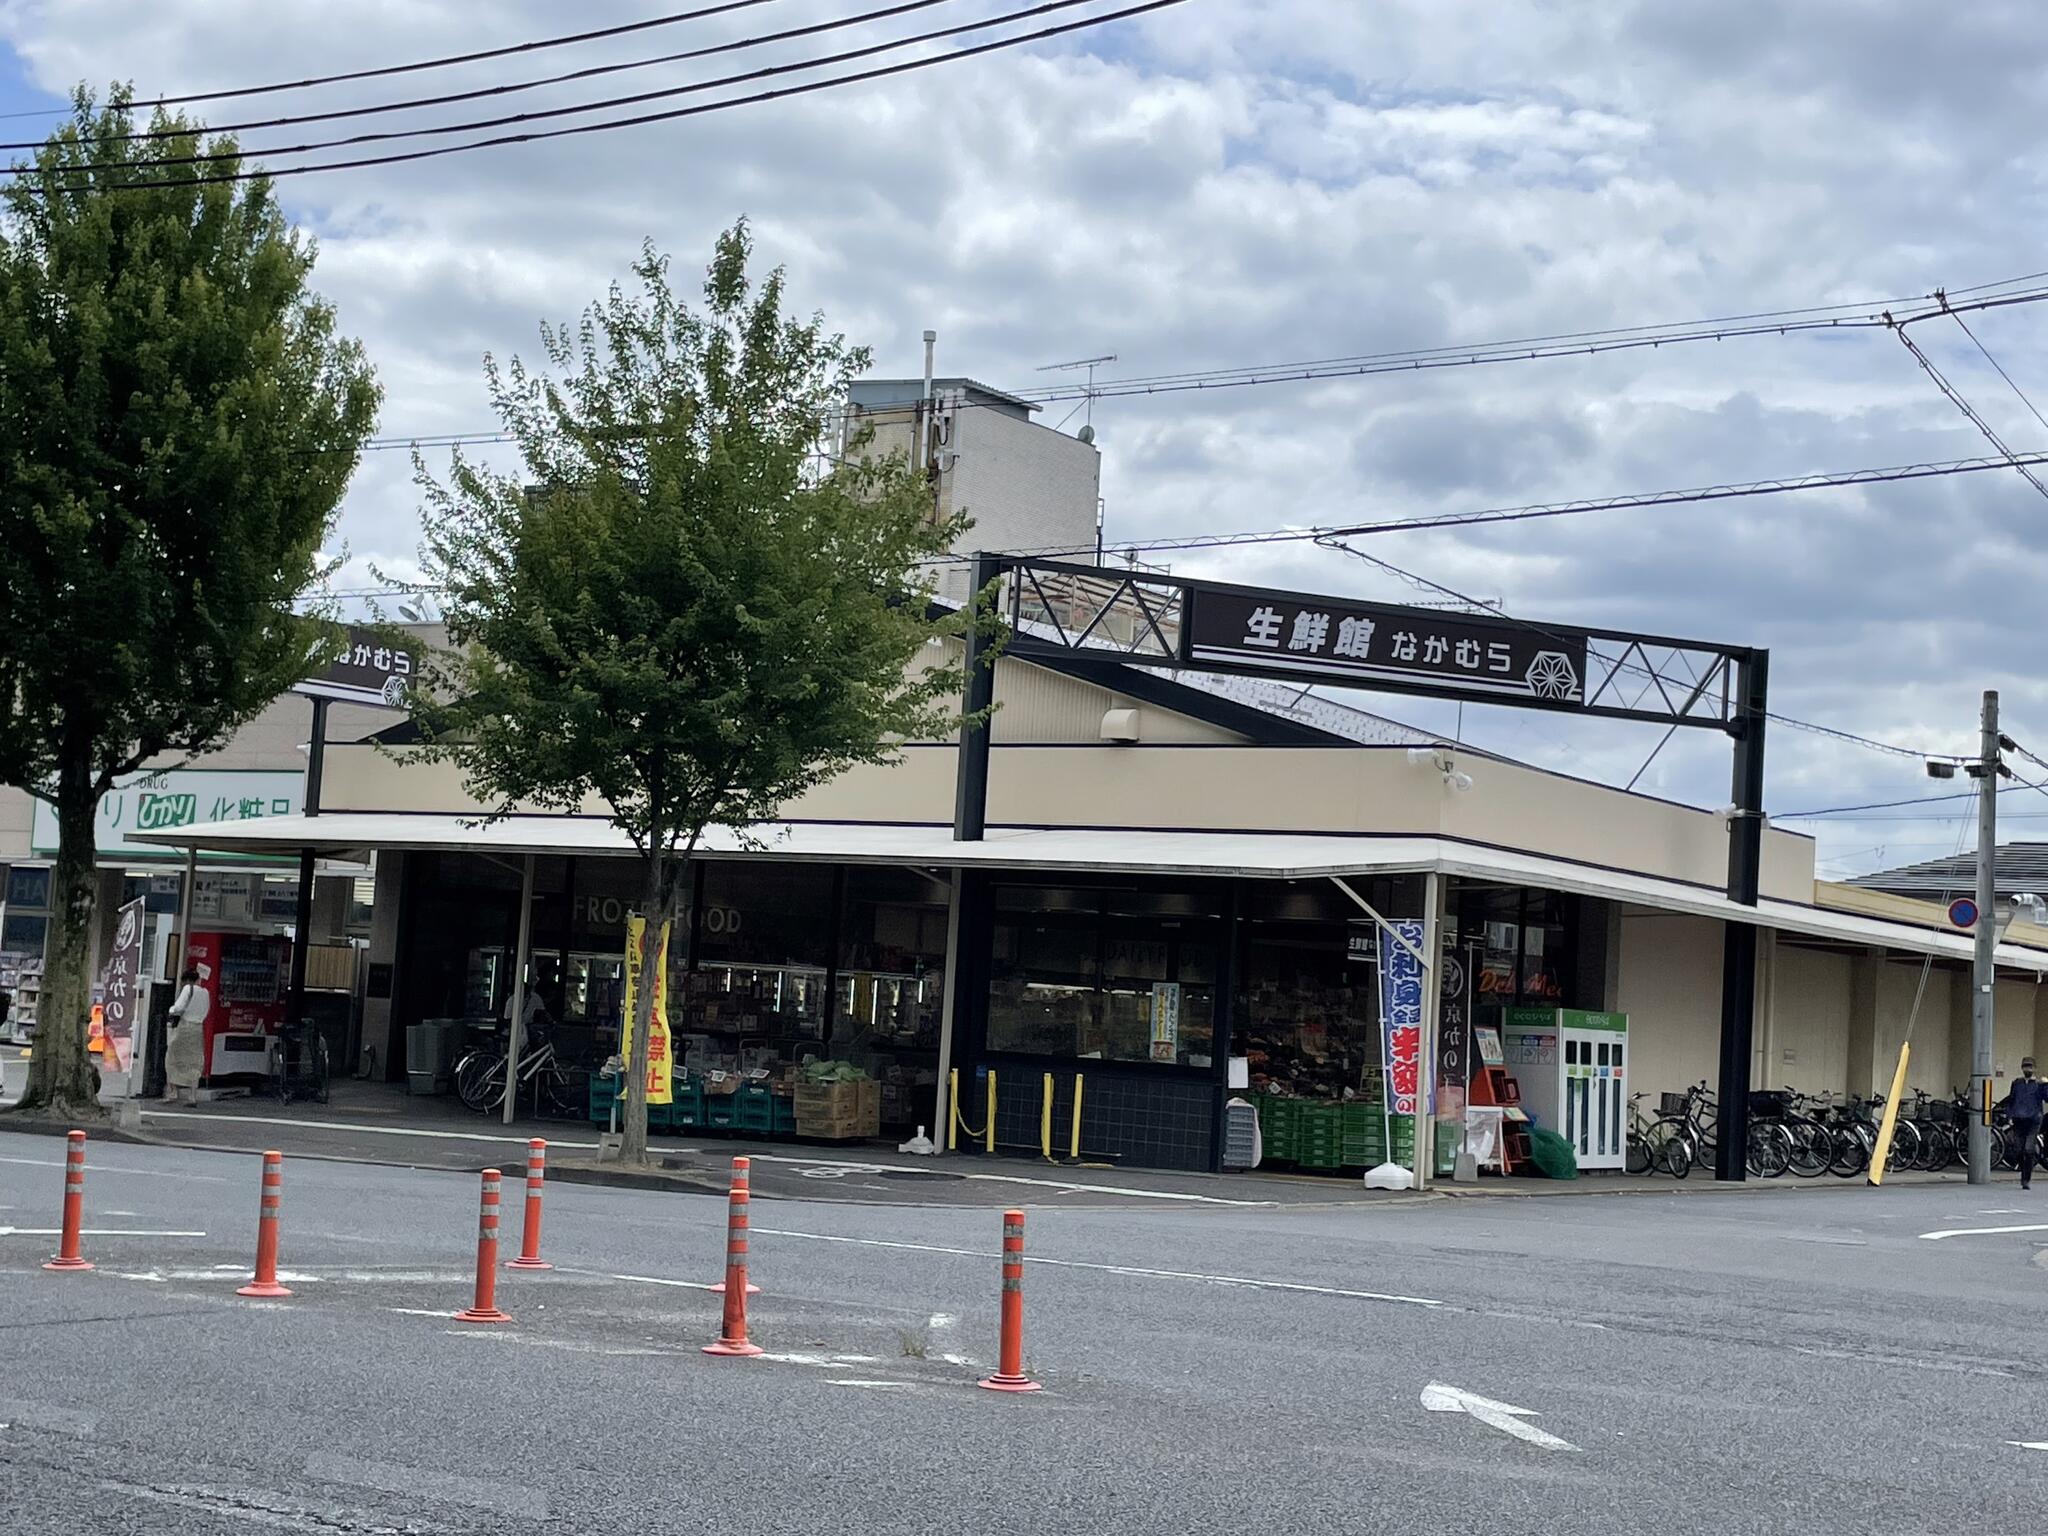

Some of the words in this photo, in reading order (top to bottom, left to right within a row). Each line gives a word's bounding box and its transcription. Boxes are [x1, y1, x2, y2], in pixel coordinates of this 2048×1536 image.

[1242, 606, 1376, 660] 生鮮館
[1390, 630, 1511, 673] なかむら
[138, 794, 196, 829] ひかり
